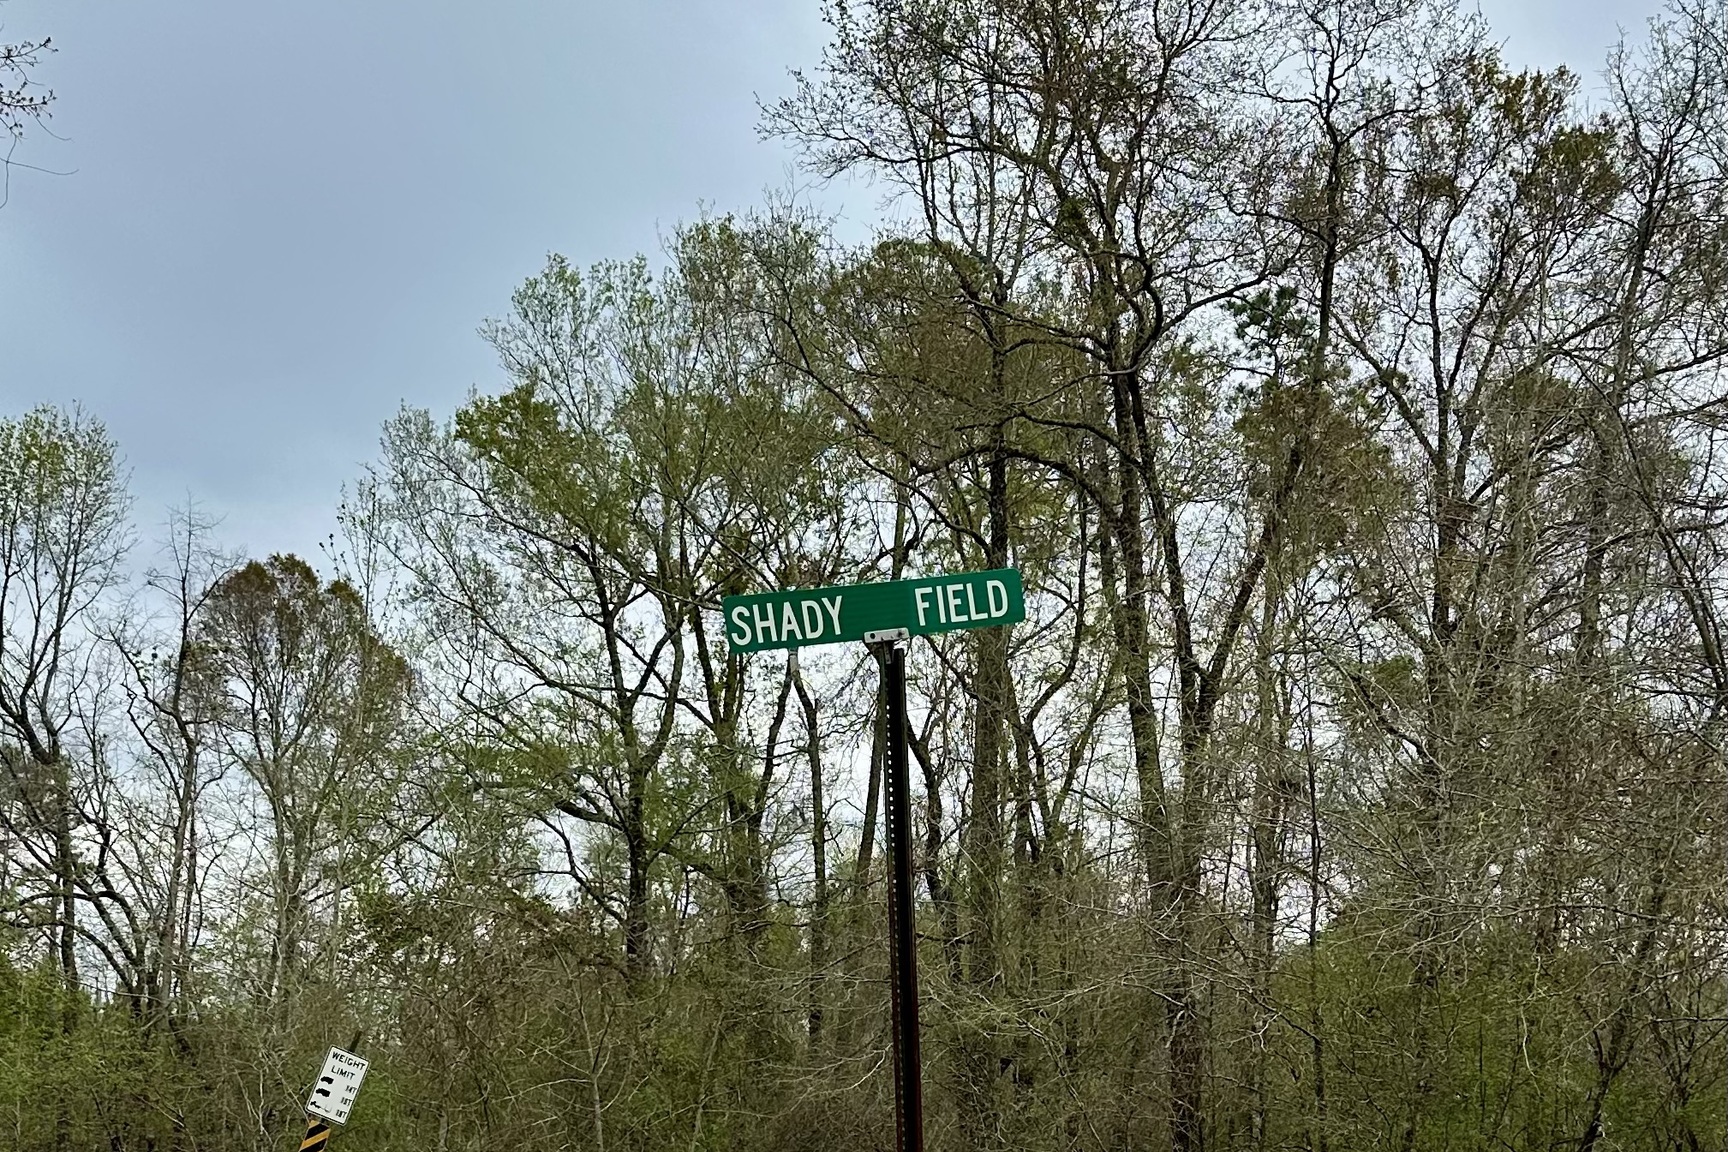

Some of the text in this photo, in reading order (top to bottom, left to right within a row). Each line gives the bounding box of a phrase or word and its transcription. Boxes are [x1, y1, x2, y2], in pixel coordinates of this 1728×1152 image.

[731, 579, 1009, 646] SHADY FIELD
[331, 1051, 366, 1071] WEIGHT
[330, 1064, 356, 1081] LIMIT
